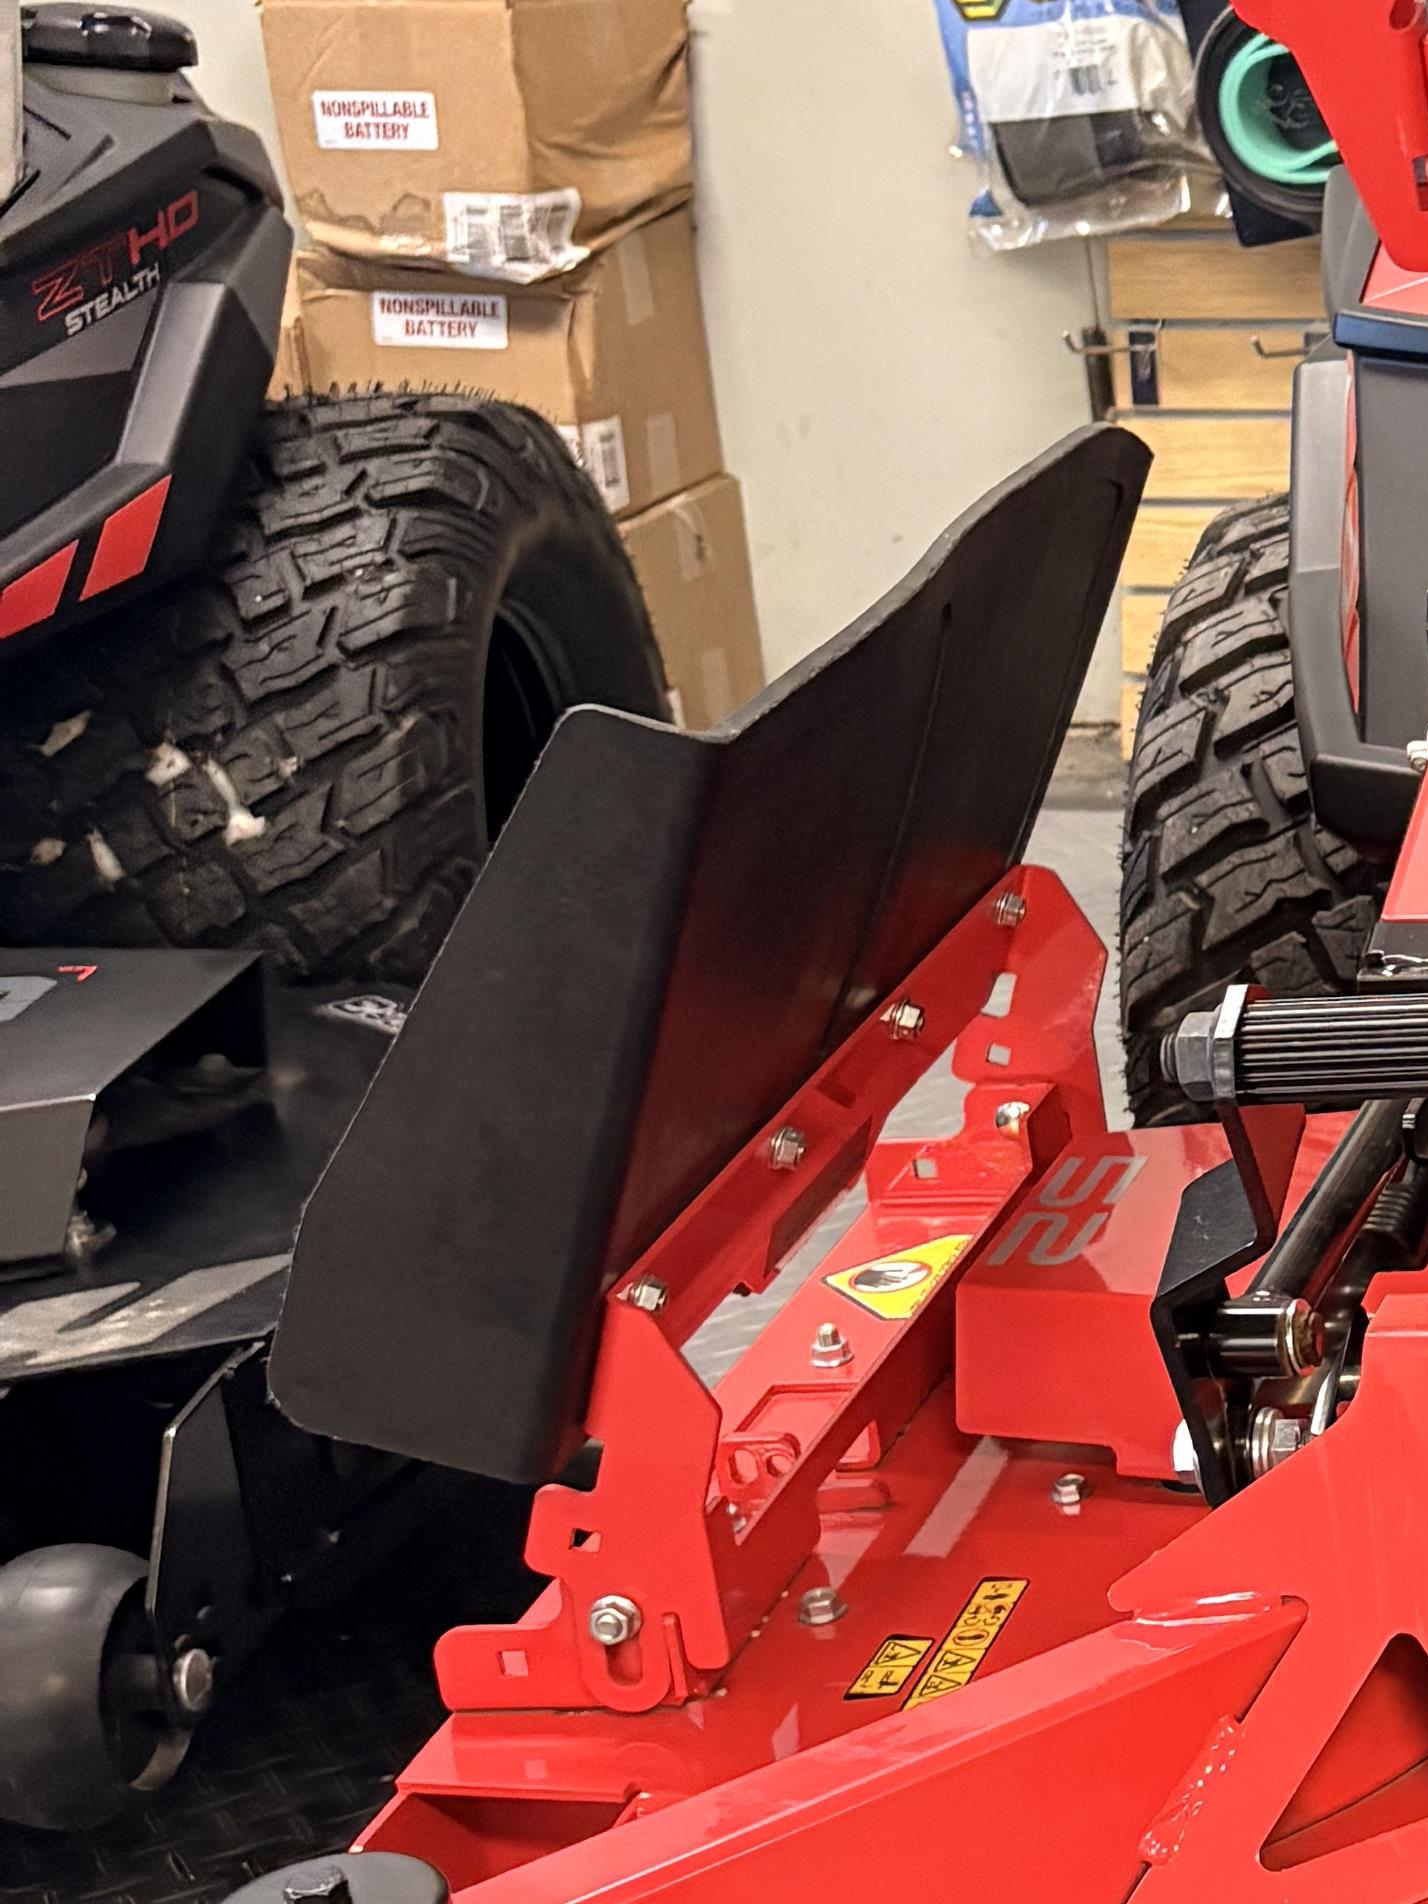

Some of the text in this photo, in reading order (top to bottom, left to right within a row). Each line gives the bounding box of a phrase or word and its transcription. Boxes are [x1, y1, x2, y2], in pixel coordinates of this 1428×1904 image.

[321, 99, 430, 119] NONSPILLABLE
[343, 121, 409, 139] BATTERY
[64, 261, 160, 336] STEALTH
[380, 298, 499, 317] NONSPILLABLE
[404, 320, 477, 338] BATTERY
[983, 1155, 1148, 1266] 52
